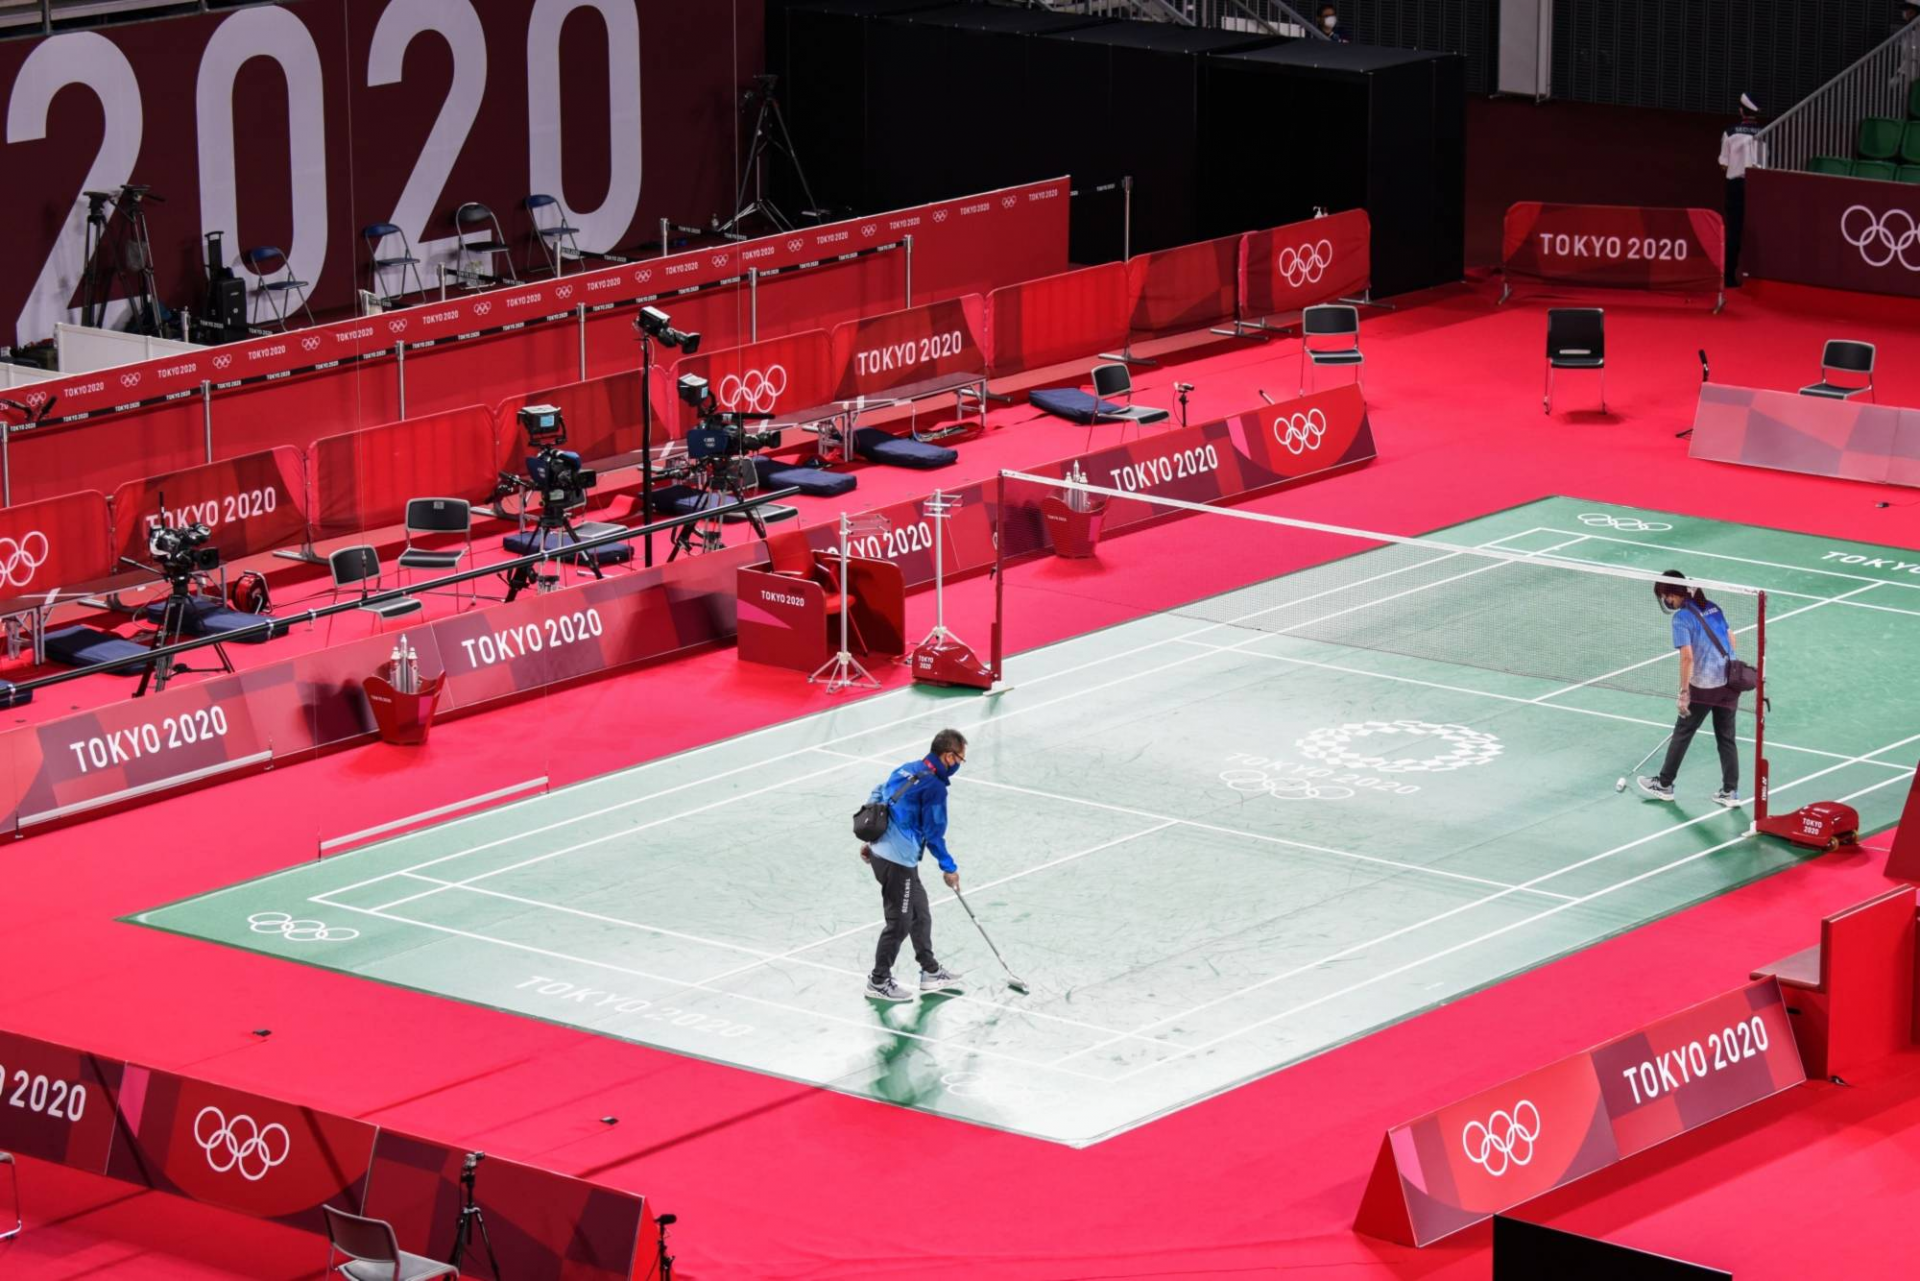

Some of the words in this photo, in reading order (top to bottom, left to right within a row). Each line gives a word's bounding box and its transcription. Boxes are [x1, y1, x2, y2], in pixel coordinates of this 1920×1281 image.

[6, 0, 642, 350] 2020
[1028, 191, 1045, 202] TOKYO
[1045, 188, 1058, 199] 2020
[960, 205, 976, 216] TOKYO
[977, 202, 990, 213] 2020
[889, 219, 907, 230] TOKYO
[907, 216, 921, 227] 2020
[816, 233, 834, 245] TOKYO
[835, 231, 849, 242] 2020
[742, 249, 760, 261] TOKYO
[760, 246, 775, 257] 2020
[1539, 233, 1621, 259] TOKYO
[1627, 237, 1688, 261] 2020
[665, 264, 683, 275] TOKYO
[684, 261, 699, 272] 2020
[587, 280, 606, 291] TOKYO
[606, 277, 621, 288] 2020
[507, 296, 526, 308] TOKYO
[526, 293, 541, 304] 2020
[422, 313, 442, 325] TOKYO
[443, 310, 459, 321] 2020
[336, 330, 356, 342] TOKYO
[357, 327, 374, 338] 2020
[248, 348, 269, 360] TOKYO
[270, 345, 286, 357] 2020
[858, 341, 916, 376] TOKYO
[920, 330, 962, 362] 2020
[157, 366, 180, 379] TOKYO
[180, 363, 196, 374] 2020
[65, 386, 87, 398] TOKYO
[88, 382, 104, 393] 2020
[1110, 456, 1173, 492] TOKYO
[1173, 444, 1218, 478] 2020
[224, 486, 276, 523] 2020
[883, 522, 933, 559] 2020
[761, 590, 786, 603] TOKYO
[786, 595, 805, 607] 2020
[460, 623, 543, 668] TOKYO
[544, 608, 603, 648] 2020
[69, 723, 161, 773] TOKYO
[162, 705, 228, 749] 2020
[1225, 752, 1335, 777] TOKYO
[1332, 774, 1421, 794] 2020
[1802, 817, 1823, 829] TOKYO
[1803, 826, 1819, 836] 2020
[515, 975, 652, 1014] TOKYO
[642, 1007, 755, 1038] 2020
[1623, 1041, 1708, 1105] TOKYO
[1708, 1015, 1769, 1071] 2020
[9, 1069, 87, 1122] 2020
